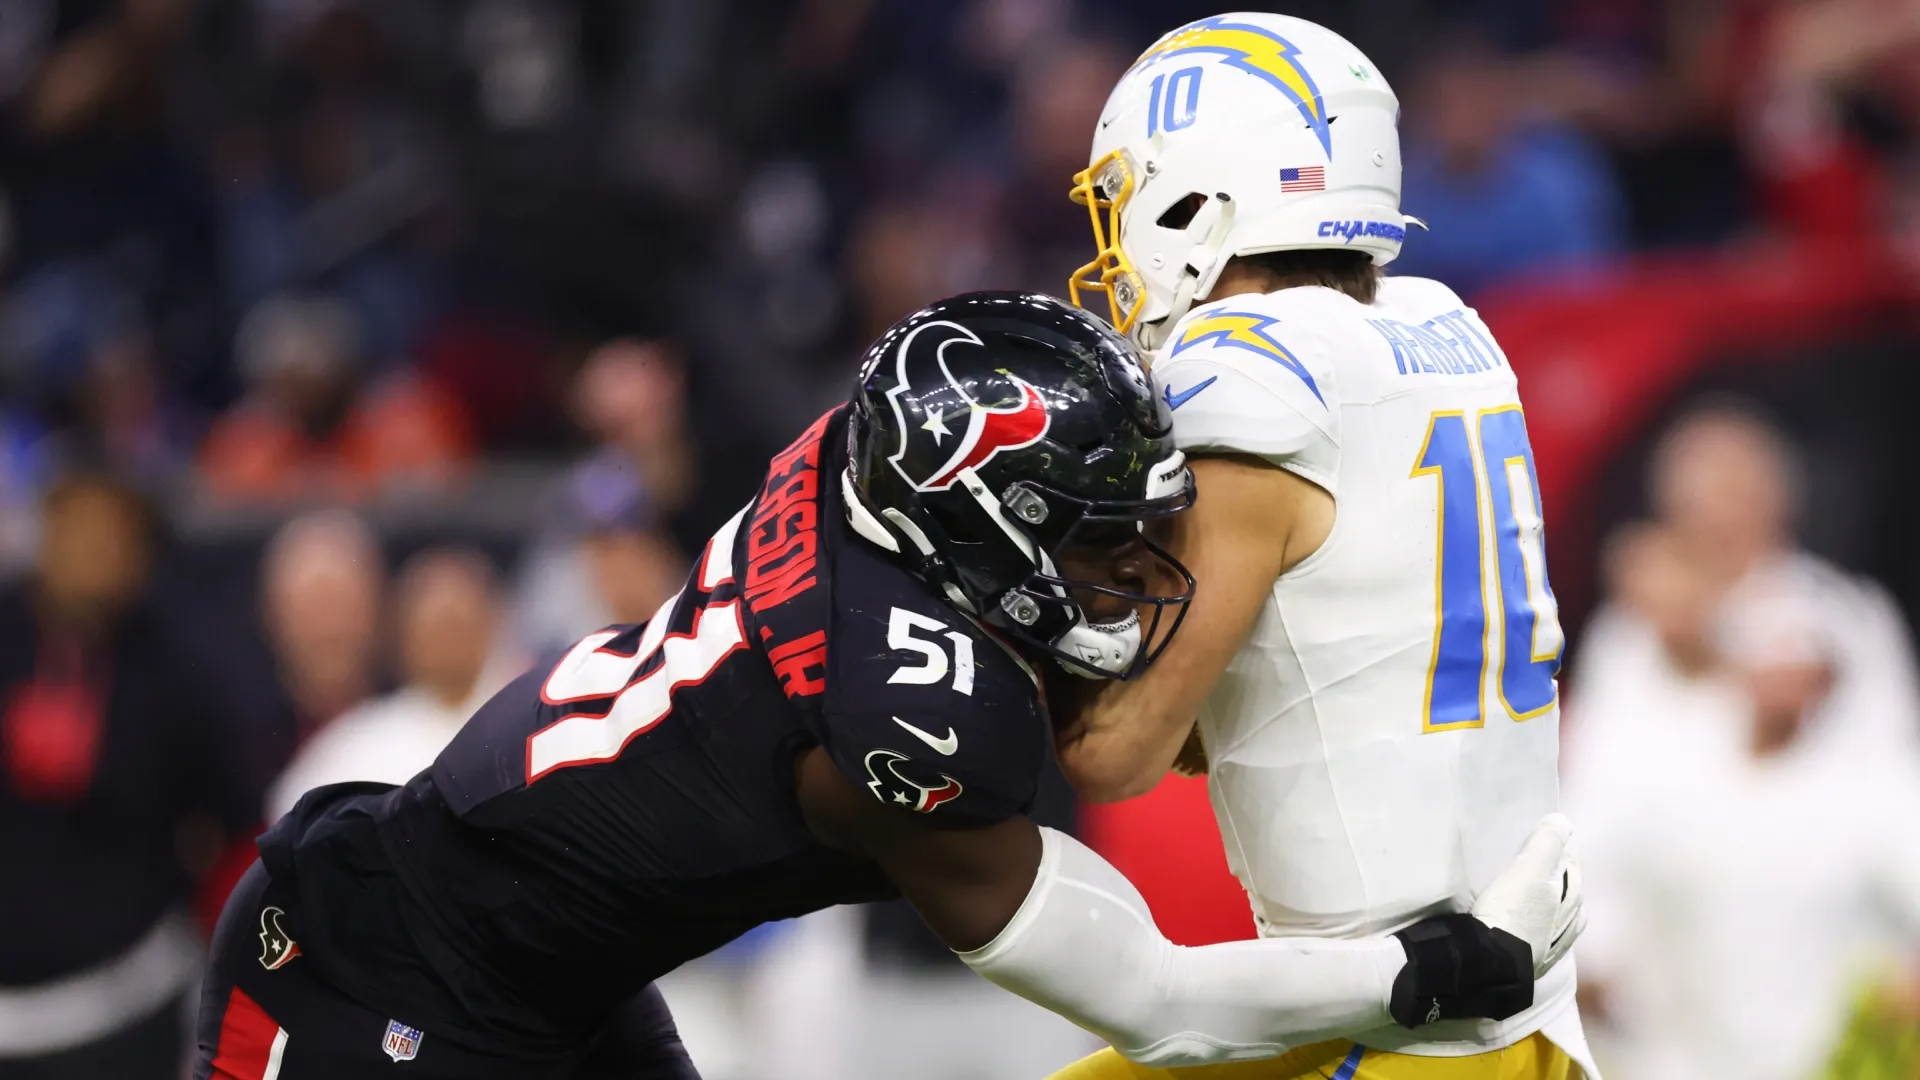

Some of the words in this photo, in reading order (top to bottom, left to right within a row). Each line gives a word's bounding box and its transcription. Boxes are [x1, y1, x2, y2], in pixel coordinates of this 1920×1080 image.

[1148, 66, 1203, 138] 10
[1409, 403, 1566, 734] 10
[525, 494, 760, 786] 51
[886, 605, 975, 696] 51
[388, 1033, 413, 1055] NFL
